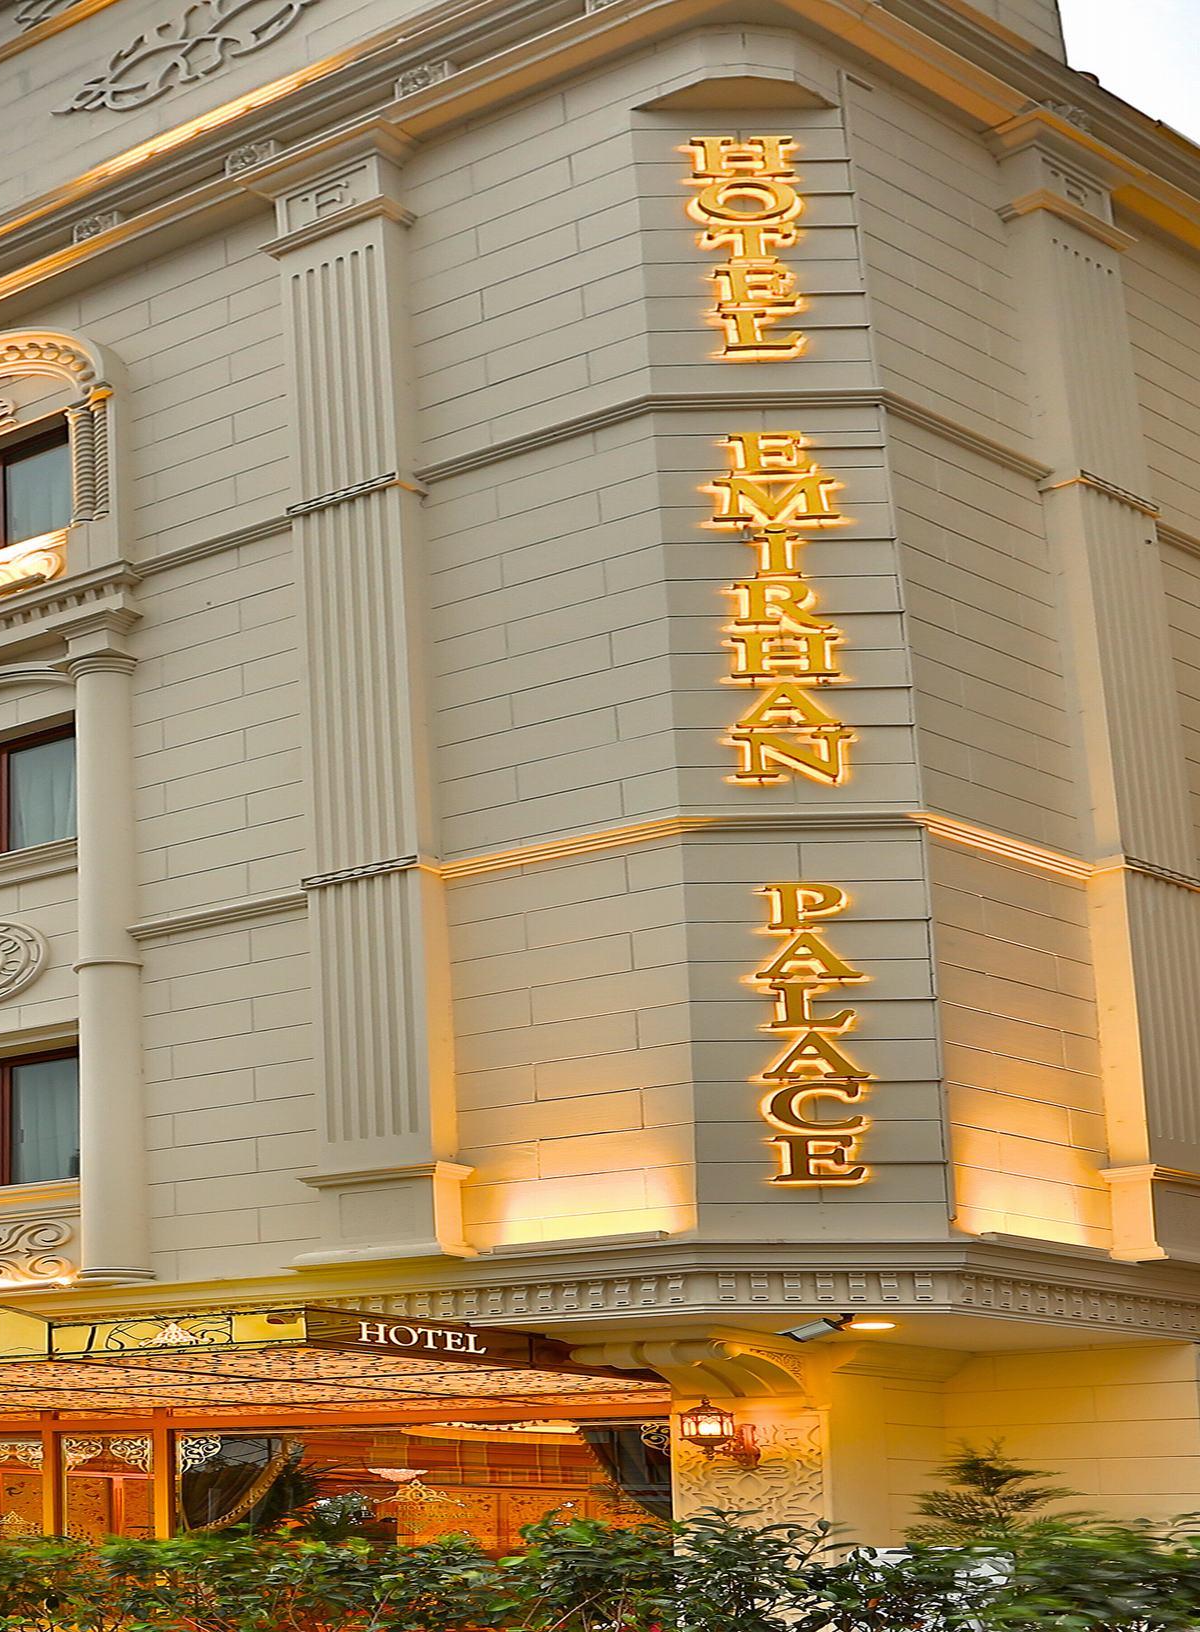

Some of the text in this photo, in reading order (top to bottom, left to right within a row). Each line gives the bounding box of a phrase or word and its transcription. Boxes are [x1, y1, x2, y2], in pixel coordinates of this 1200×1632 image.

[682, 135, 806, 359] HOTEL
[751, 883, 872, 1183] PALACE
[358, 1320, 486, 1354] HOTEL
